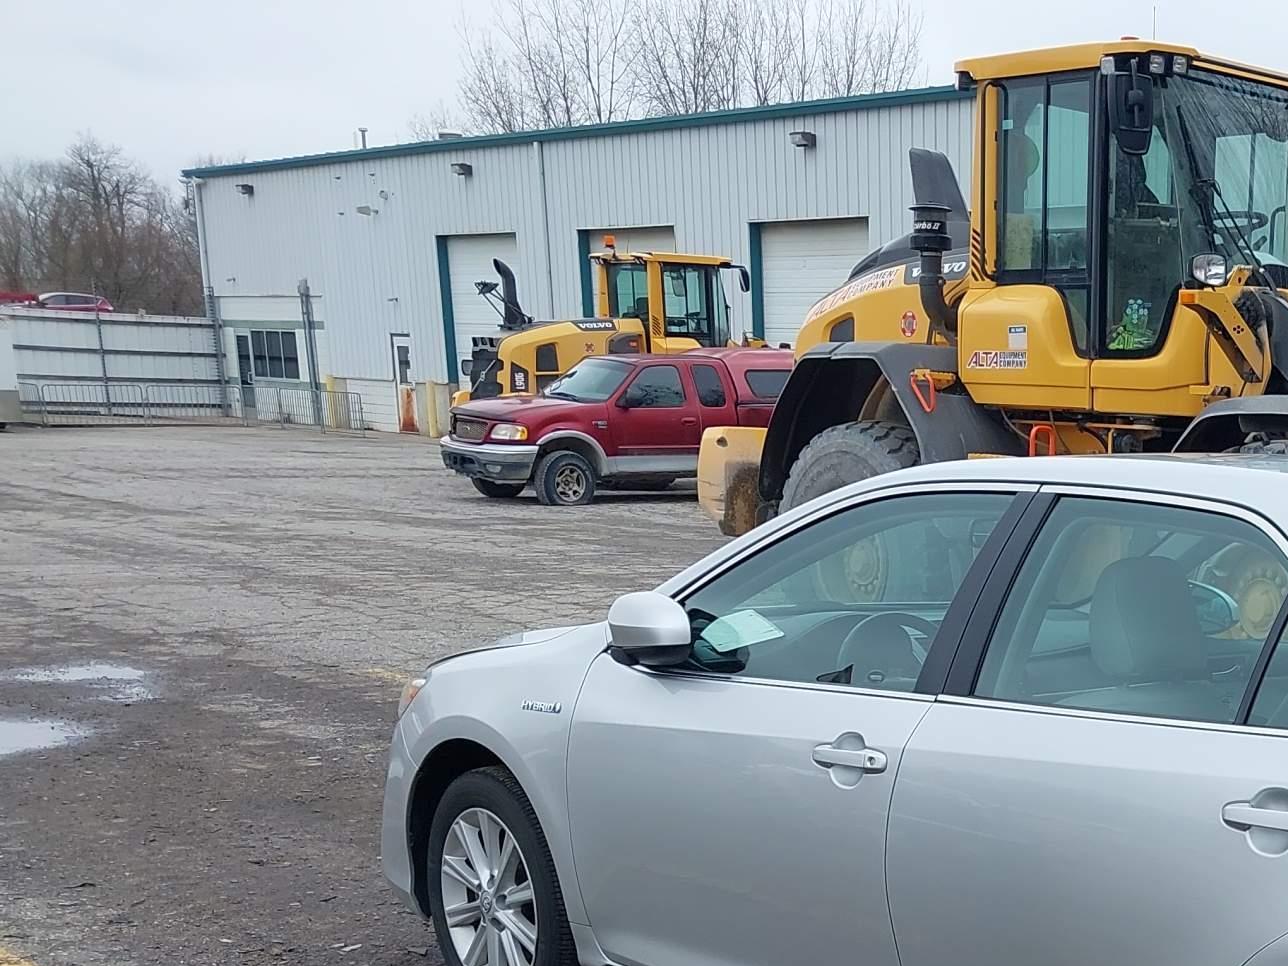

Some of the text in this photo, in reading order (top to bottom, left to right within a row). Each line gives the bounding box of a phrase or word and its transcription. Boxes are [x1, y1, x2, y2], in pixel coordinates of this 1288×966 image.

[911, 261, 966, 278] VVO
[967, 351, 999, 367] ALTA
[999, 351, 1027, 359] EQUIPMENT
[999, 360, 1027, 368] COMPANY
